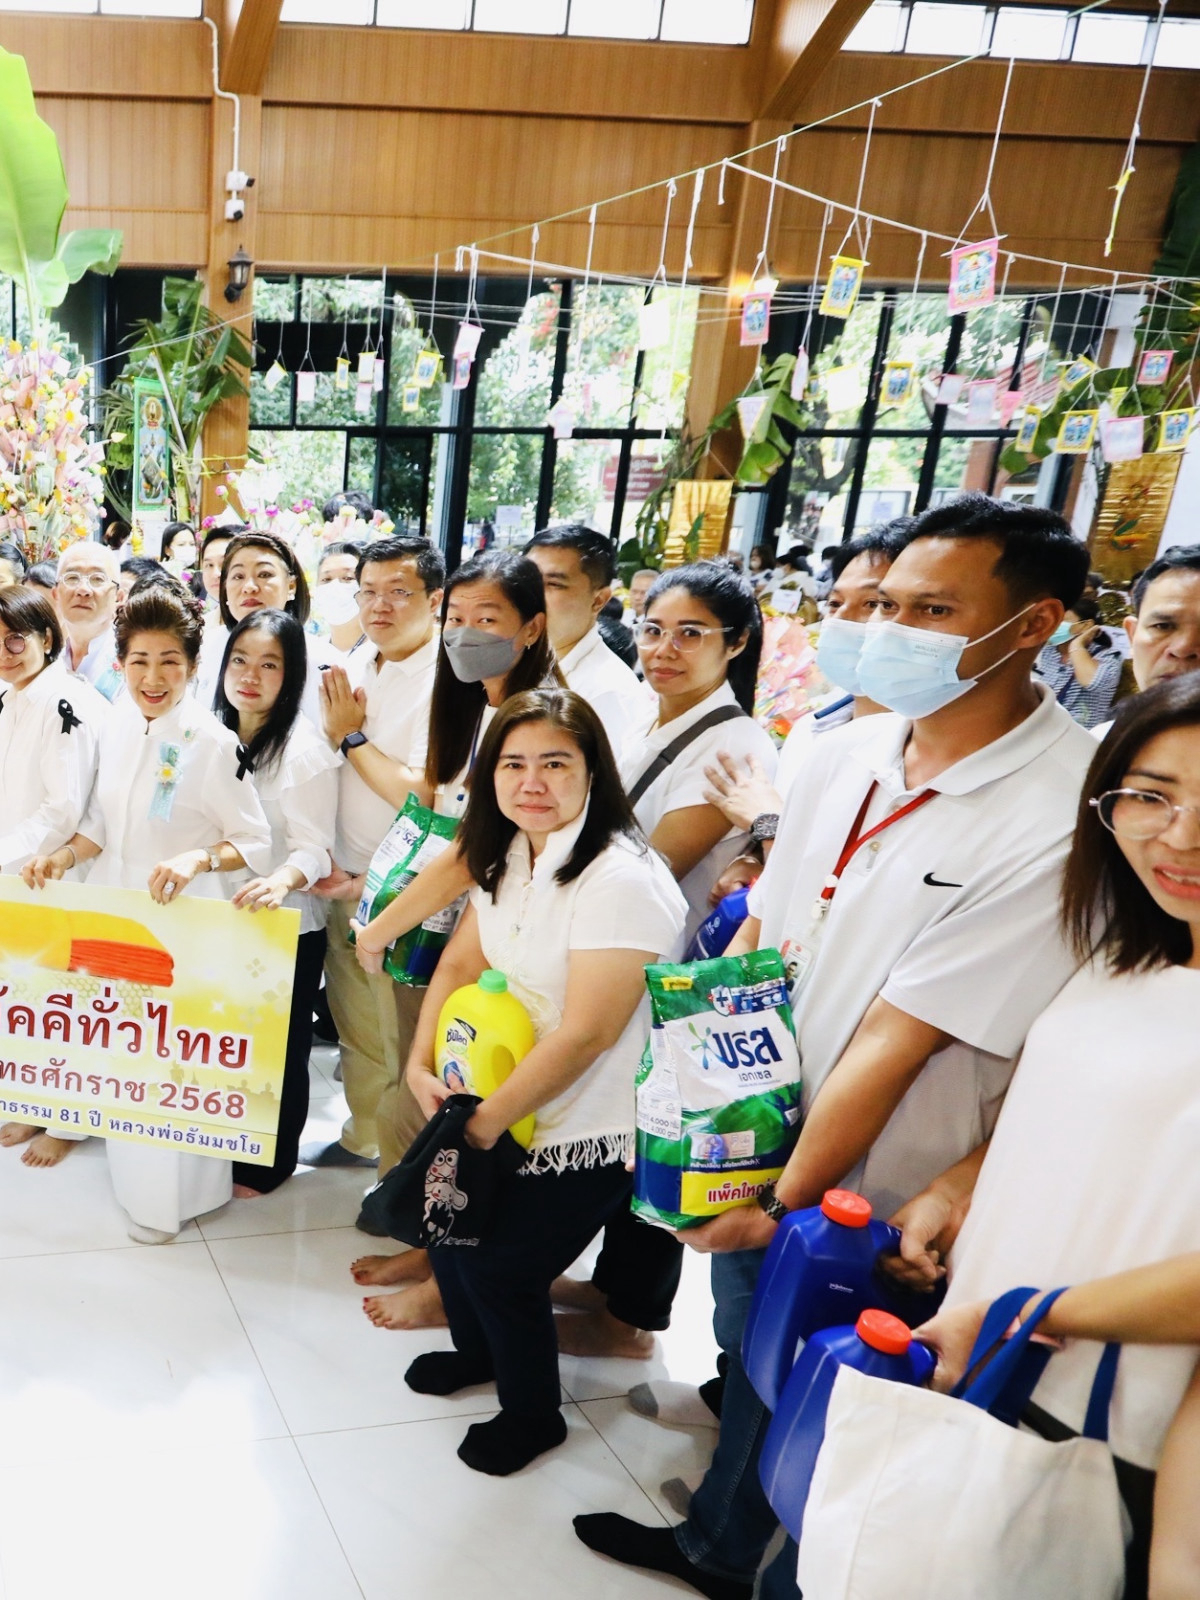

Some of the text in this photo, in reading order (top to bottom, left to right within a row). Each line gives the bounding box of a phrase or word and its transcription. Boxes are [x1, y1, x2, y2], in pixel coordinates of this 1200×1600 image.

[712, 1026, 783, 1069] บรีส
[159, 1082, 245, 1119] 2568
[60, 1108, 80, 1124] 81
[89, 1110, 101, 1127] ปี
[109, 1118, 261, 1155] หลวงพ่อธัมมชโย
